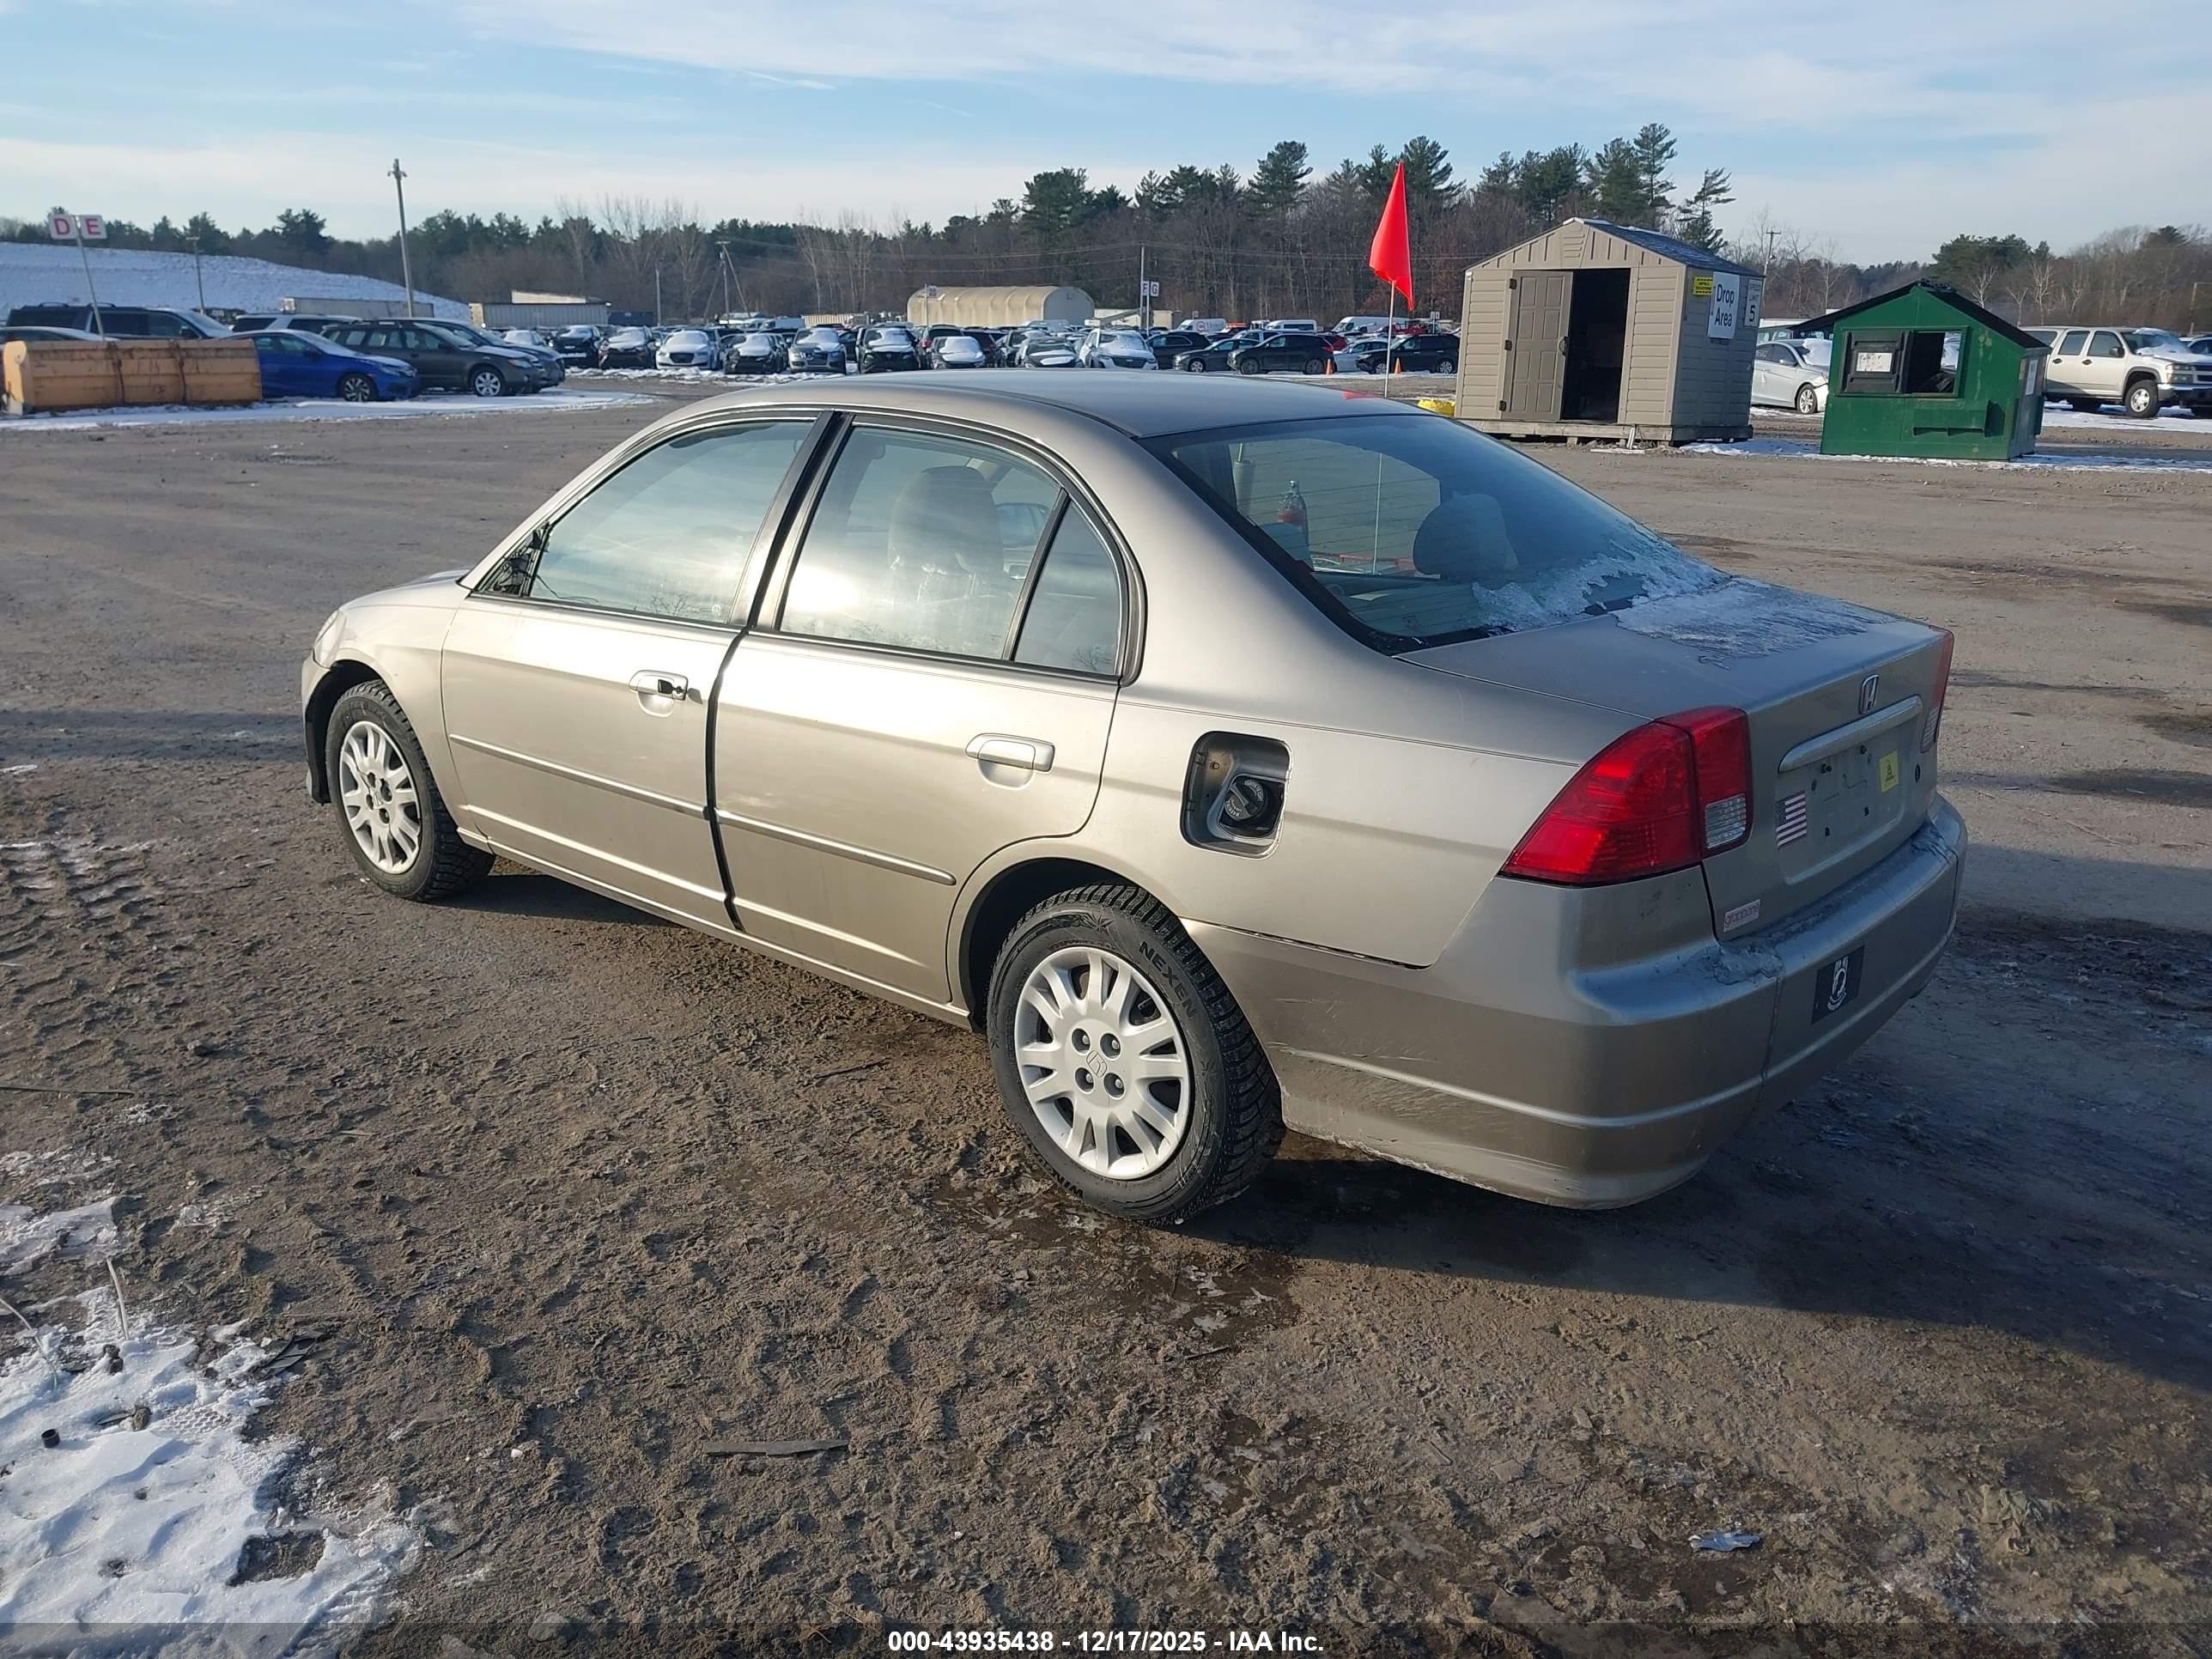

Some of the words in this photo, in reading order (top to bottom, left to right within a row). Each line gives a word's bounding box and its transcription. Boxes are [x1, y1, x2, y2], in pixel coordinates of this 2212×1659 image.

[53, 218, 70, 235] D
[85, 218, 101, 235] E
[1143, 283, 1147, 294] F
[1152, 284, 1158, 295] G
[1717, 284, 1735, 307] Drop
[1714, 307, 1733, 327] Area
[1749, 305, 1756, 323] 5
[1139, 940, 1197, 1019] NEXEN
